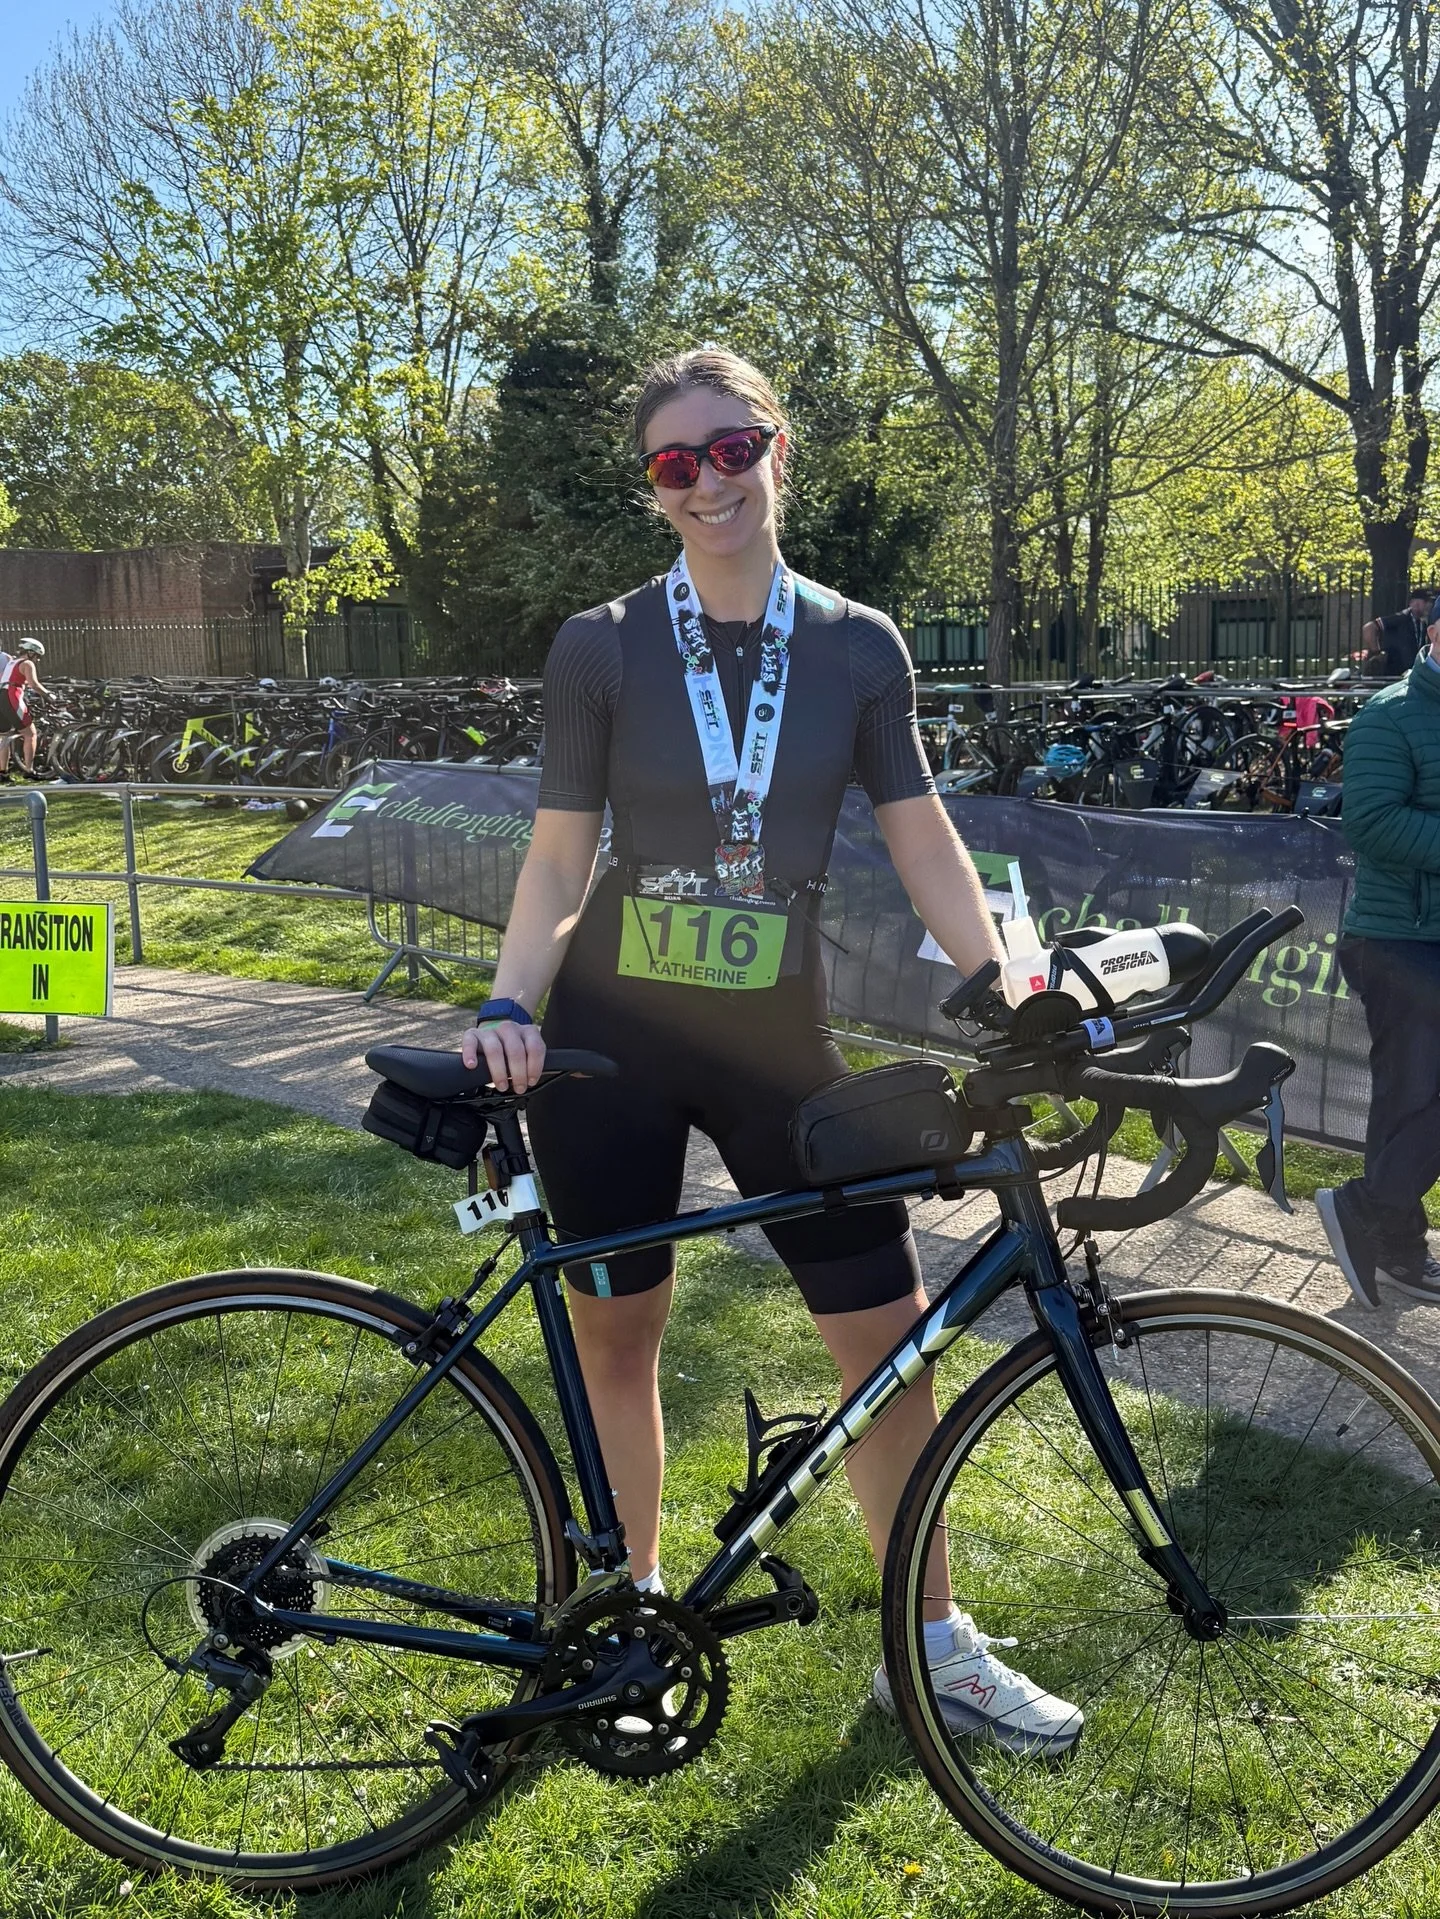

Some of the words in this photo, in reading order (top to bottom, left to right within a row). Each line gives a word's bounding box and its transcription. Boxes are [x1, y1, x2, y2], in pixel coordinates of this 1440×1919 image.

[697, 689, 719, 730] SFTT
[751, 732, 768, 775] SFTT
[376, 796, 536, 851] challenging
[716, 855, 763, 879] SFTT
[640, 877, 709, 895] SFTT
[0, 913, 93, 952] RANSITION
[650, 905, 759, 967] 116
[649, 960, 747, 985] KATHERINE
[1100, 951, 1147, 968] PROFILE
[1103, 959, 1146, 975] DESIGN
[32, 964, 49, 1000] IN
[730, 1298, 966, 1555] TREK
[578, 1694, 617, 1710] SHIMANO
